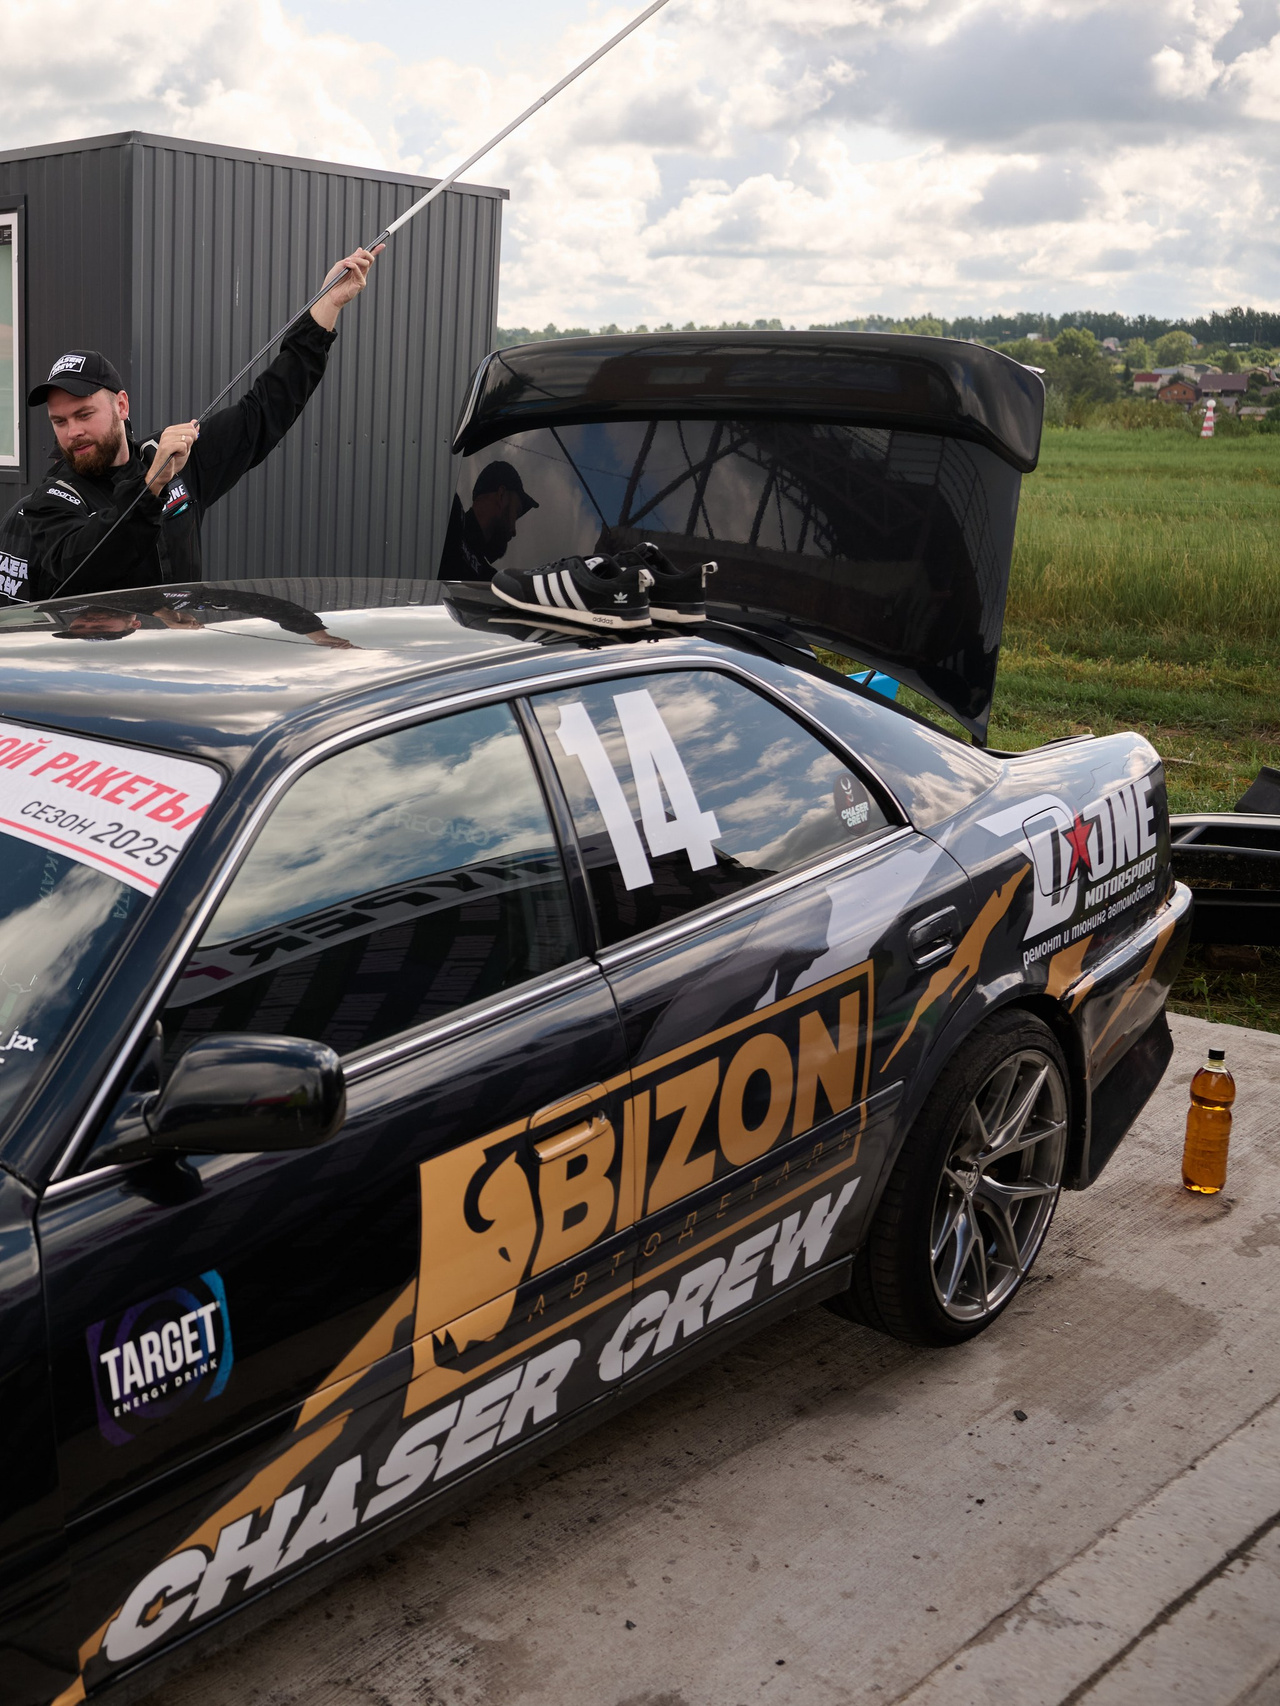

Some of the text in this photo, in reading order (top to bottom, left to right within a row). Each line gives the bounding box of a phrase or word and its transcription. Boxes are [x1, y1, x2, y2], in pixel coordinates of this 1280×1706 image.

[46, 488, 82, 506] sparco
[592, 616, 614, 625] adidas
[28, 750, 212, 832] РАКЕТЫ
[555, 689, 721, 891] 14
[841, 801, 869, 820] CHASER
[847, 812, 868, 827] CREW
[20, 800, 179, 868] СЕЗОН 2025
[394, 809, 490, 847] RECARO
[1084, 852, 1158, 910] MOTORSPORT
[1023, 936, 1062, 970] ремонт
[1063, 928, 1070, 943] и
[1071, 908, 1106, 940] тюнинг
[530, 989, 860, 1278] BIZON
[99, 1301, 217, 1401] TARGET
[114, 1358, 217, 1417] ENERGY DRINK
[101, 1176, 862, 1662] CHASER CREW
